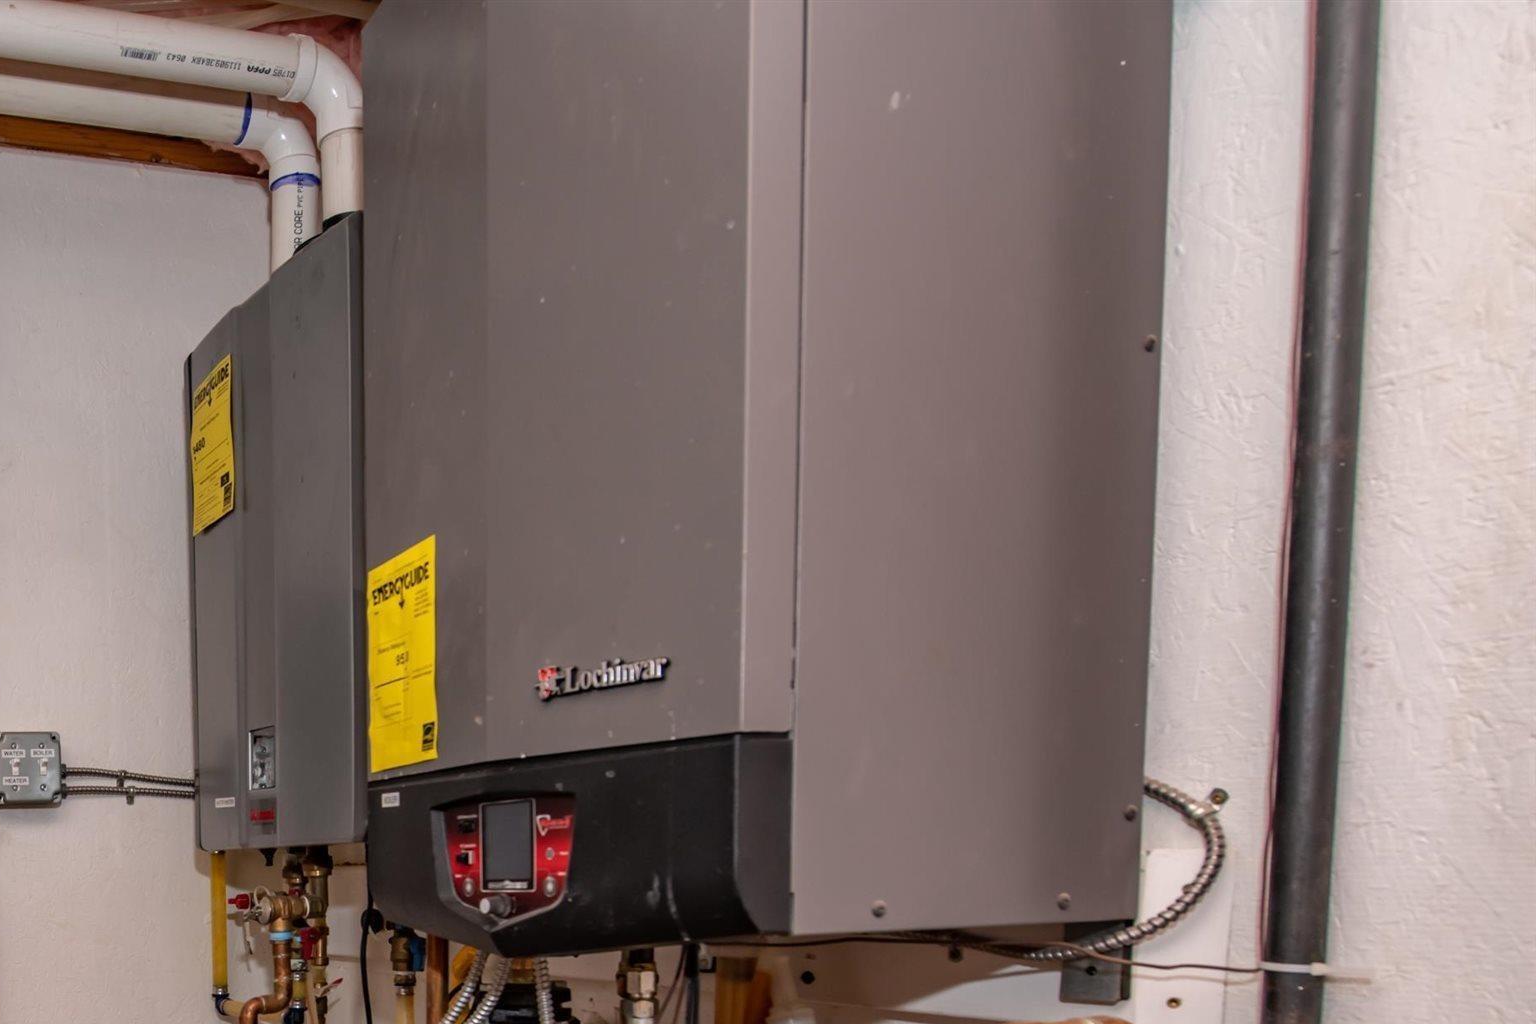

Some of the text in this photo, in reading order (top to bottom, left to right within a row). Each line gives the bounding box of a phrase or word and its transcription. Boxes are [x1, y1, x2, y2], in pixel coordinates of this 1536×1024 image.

[247, 64, 271, 75] PPFA
[293, 209, 303, 235] CORE
[563, 657, 668, 694] Lochinvar
